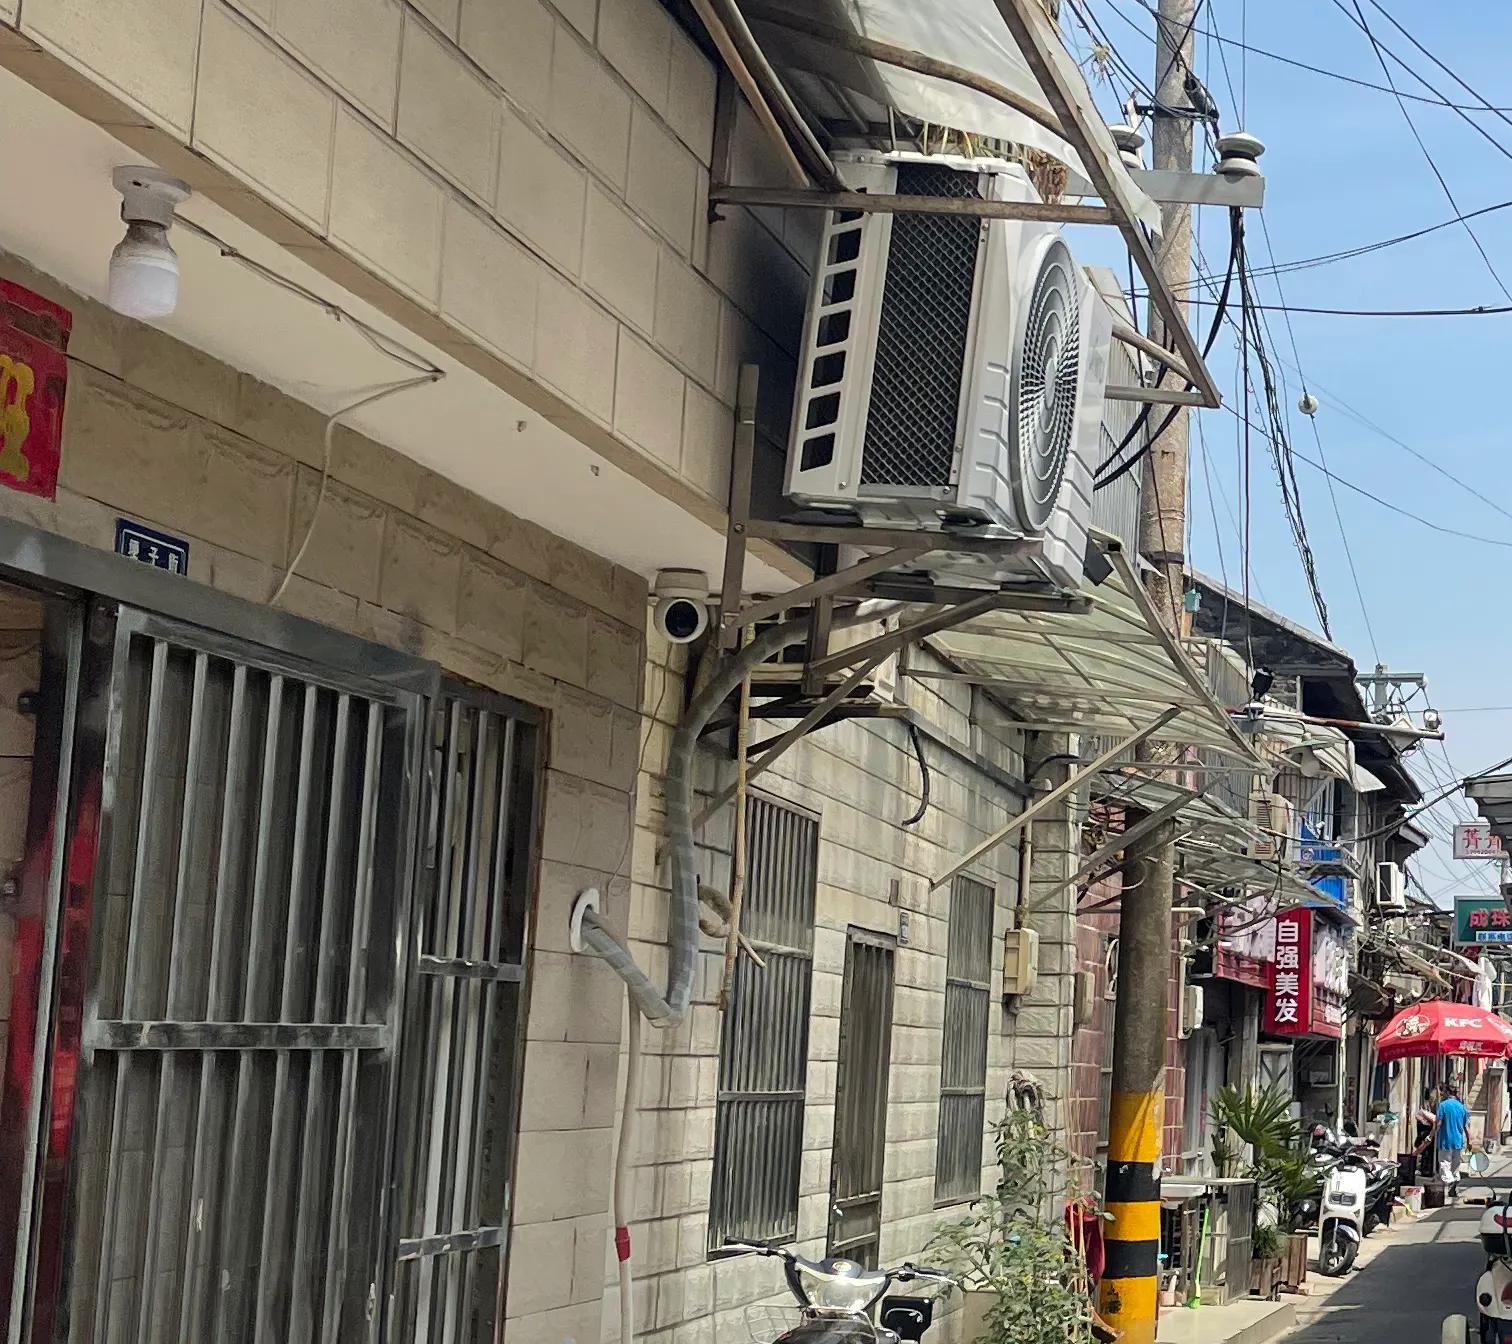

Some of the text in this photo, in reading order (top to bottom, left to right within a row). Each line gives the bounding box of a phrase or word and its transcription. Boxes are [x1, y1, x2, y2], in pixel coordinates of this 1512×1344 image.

[1275, 919, 1299, 1023] 自强美发
[1445, 1017, 1483, 1028] KFC
